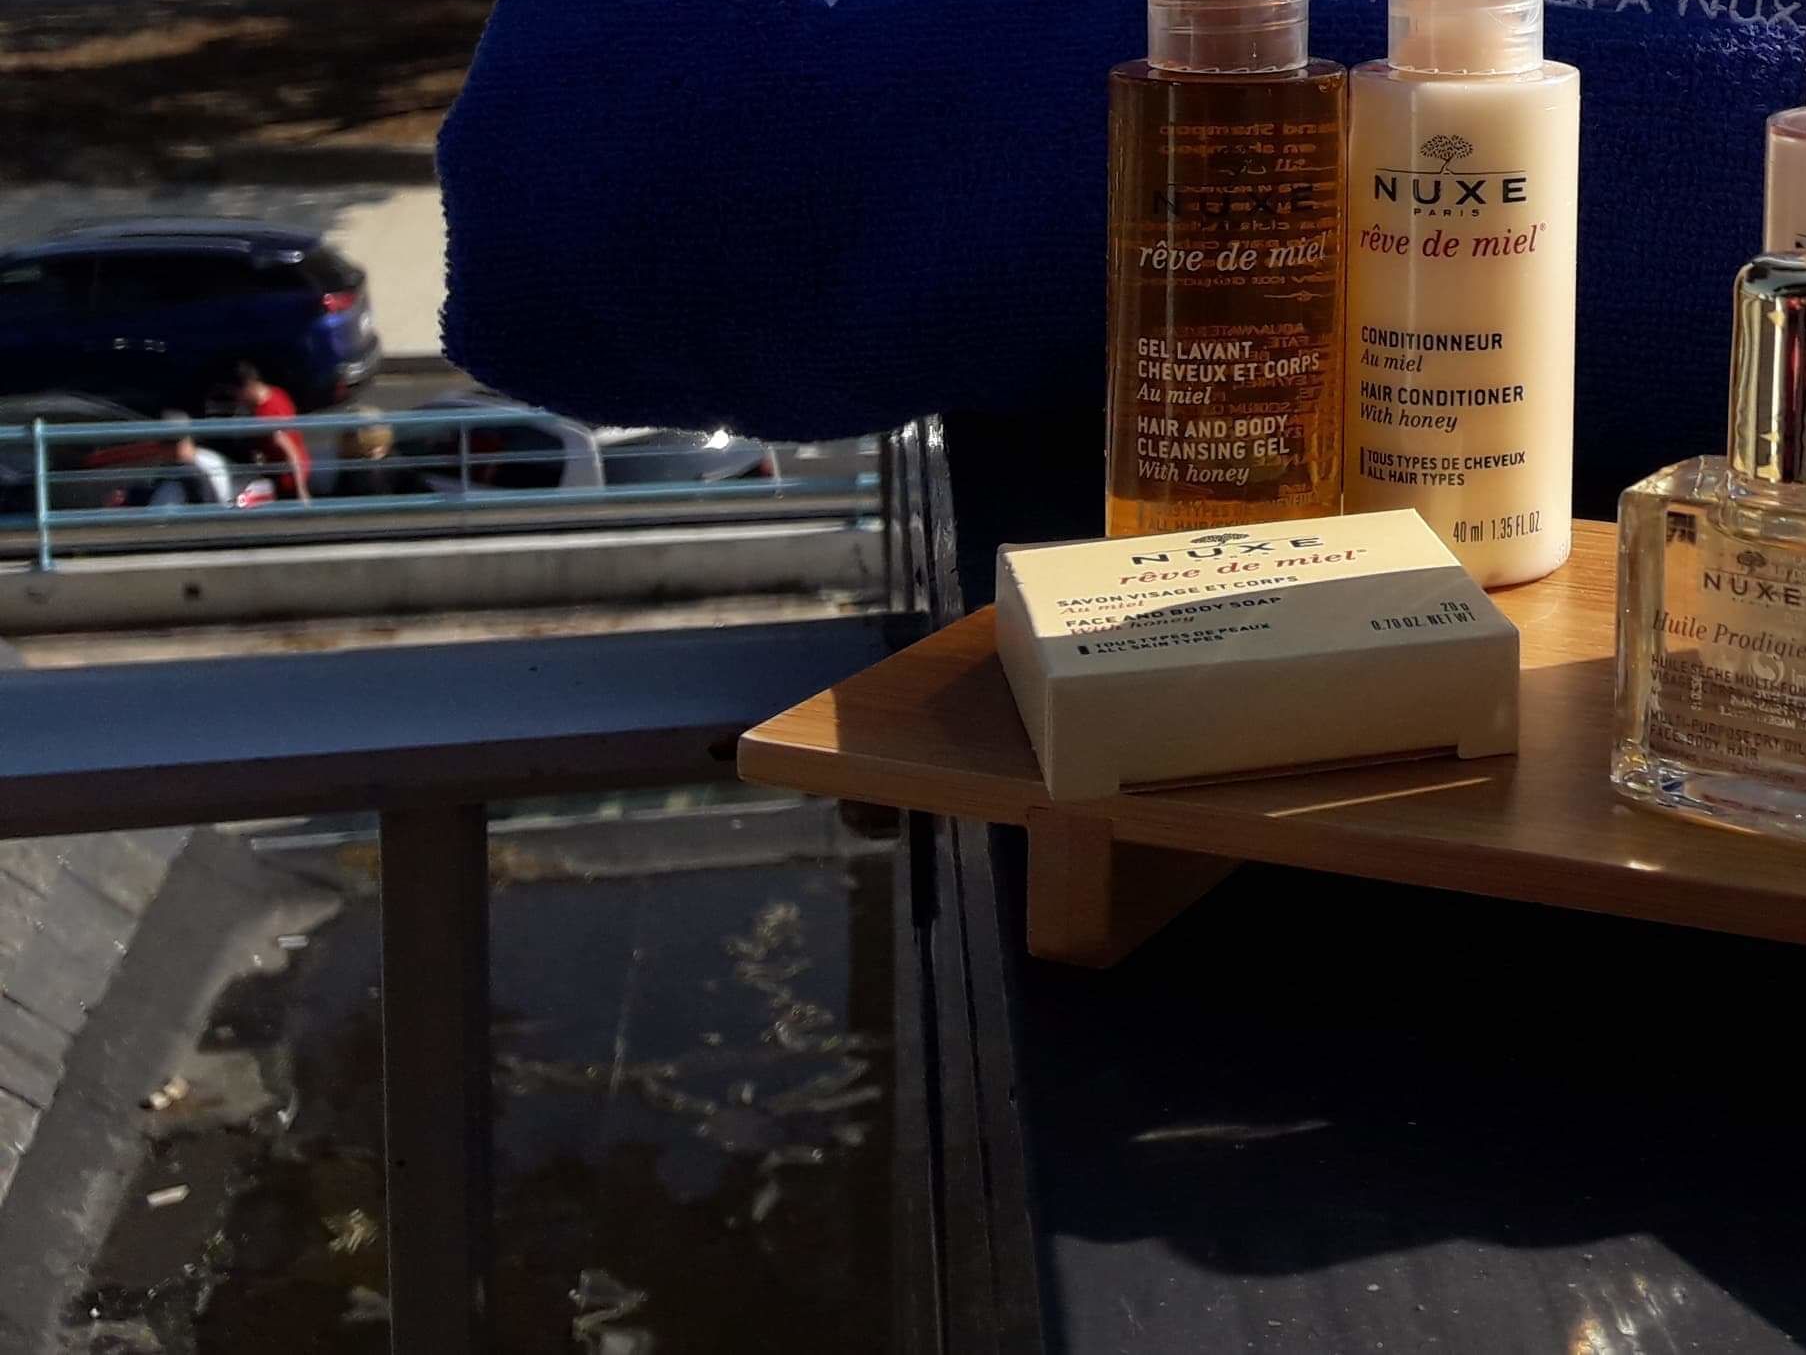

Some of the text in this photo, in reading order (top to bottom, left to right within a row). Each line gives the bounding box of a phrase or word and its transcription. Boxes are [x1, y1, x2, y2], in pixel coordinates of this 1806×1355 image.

[1374, 174, 1527, 205] NUXE
[1413, 207, 1481, 217] PARIS
[1360, 223, 1410, 255] rêve
[1422, 229, 1460, 257] de
[1138, 239, 1204, 272] rêve
[1216, 241, 1258, 272] de
[1138, 337, 1253, 360] GEL LAVANT
[1361, 325, 1503, 352] CONDITIONNEUR
[1138, 352, 1320, 383] CHEVEUX ET CORPS
[1360, 348, 1423, 373] Au miel
[1136, 381, 1212, 405] Au miel
[1360, 380, 1524, 407] HAIR CONDITIONER
[1138, 413, 1288, 438] HAIR AND BODY
[1360, 402, 1458, 433] With honey
[1138, 436, 1290, 460] CLEANSING GEL
[1367, 449, 1526, 471] TOUS TYPES DE CHEVEUX
[1138, 458, 1250, 486] With honey
[1367, 465, 1465, 486] ALL HAIR TYPES
[1453, 520, 1466, 543] 40
[1470, 519, 1484, 542] ml
[1492, 516, 1513, 541] 1.35
[1132, 536, 1325, 566] NUXE
[1119, 566, 1201, 586] rêve
[1217, 559, 1260, 575] de
[1057, 575, 1299, 608] SAVON VISAGE ET CORPS
[1703, 571, 1801, 606] NUXE
[1065, 596, 1282, 628] FACE AND BODY SOAP
[1652, 609, 1707, 640] Huile
